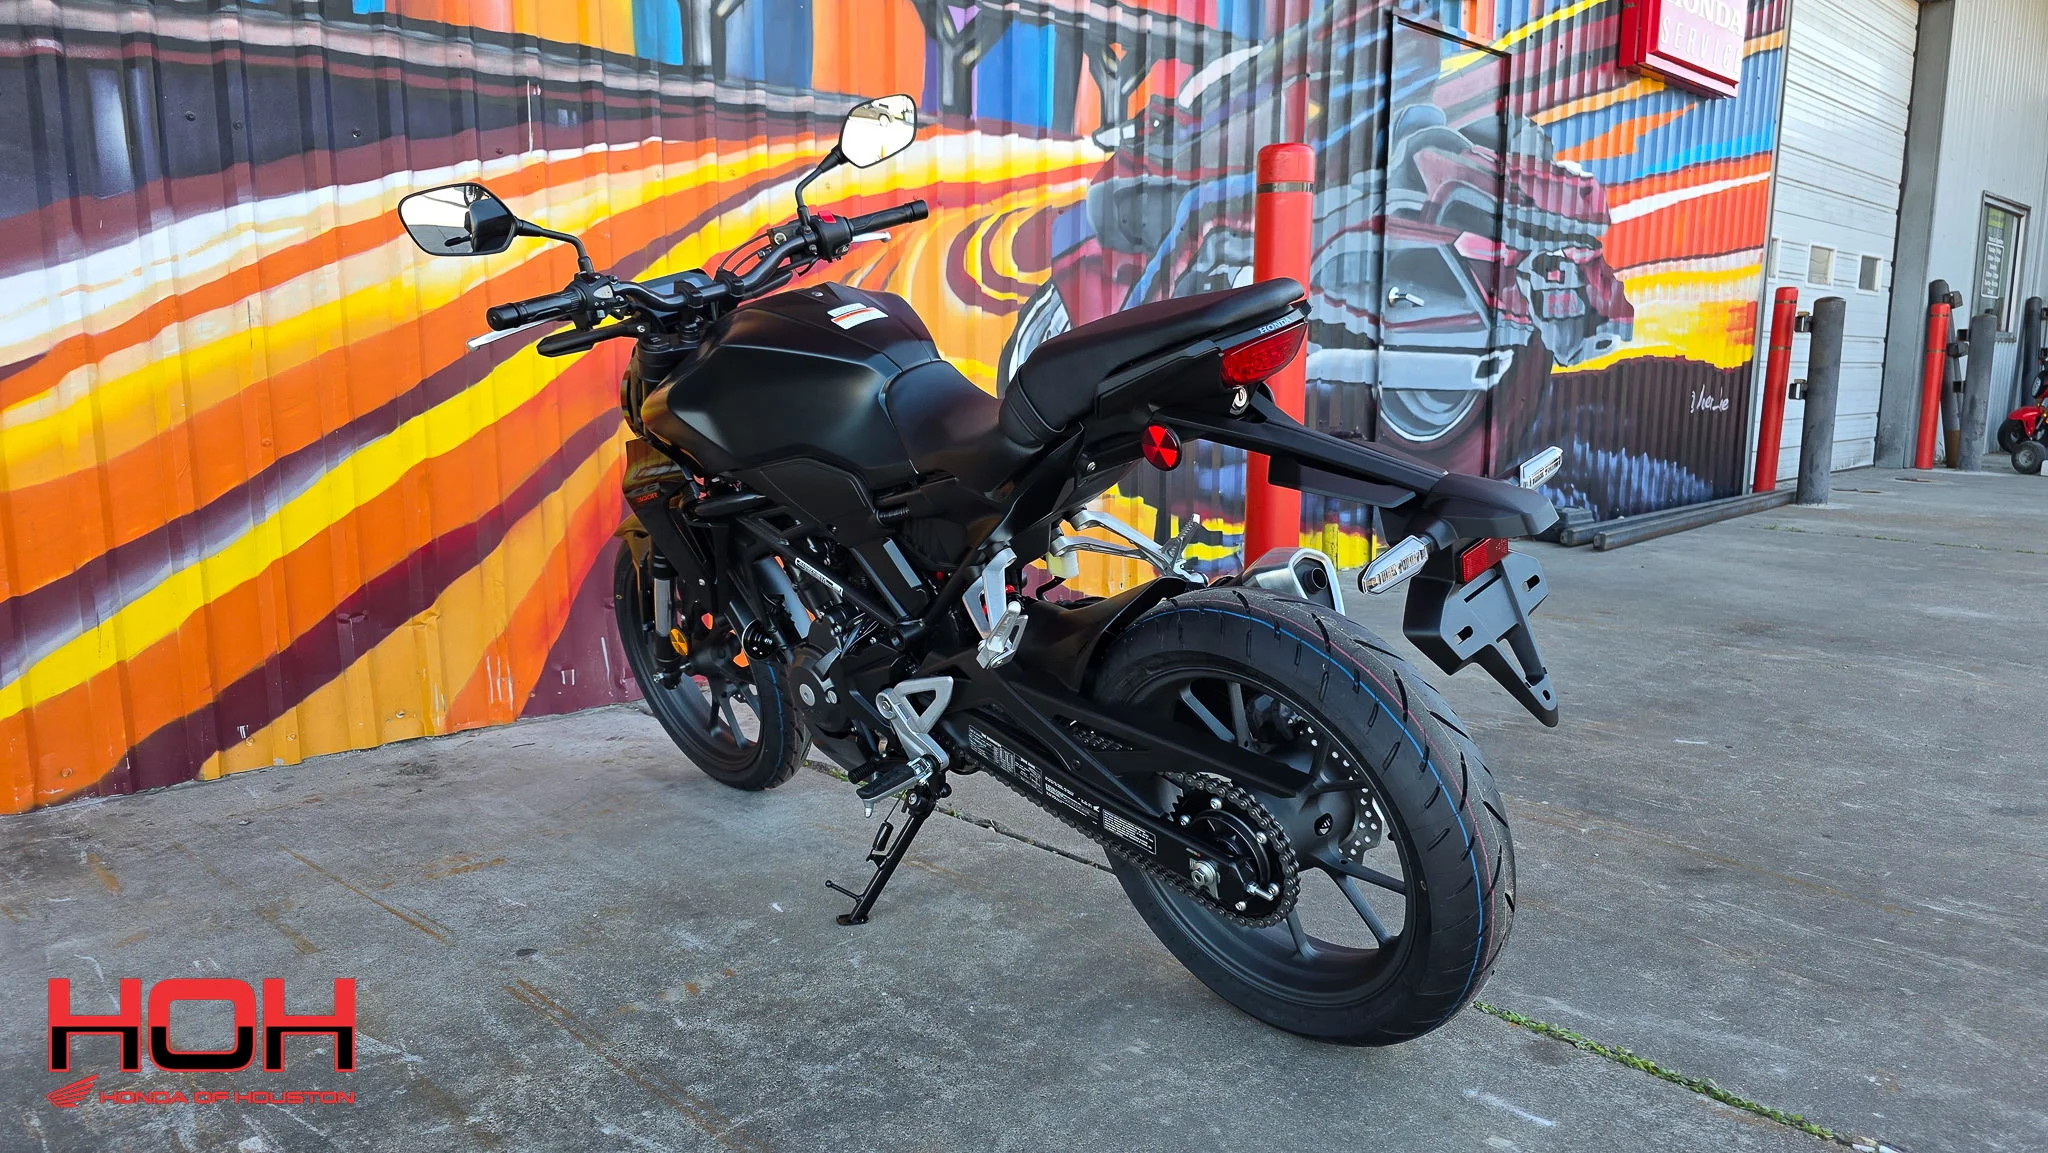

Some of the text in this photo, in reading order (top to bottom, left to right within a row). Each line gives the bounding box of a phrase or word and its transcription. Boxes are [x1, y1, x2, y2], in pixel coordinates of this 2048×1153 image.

[1664, 0, 1743, 37] ONDA
[1660, 16, 1741, 74] SERVICE
[1258, 316, 1292, 334] HONDA
